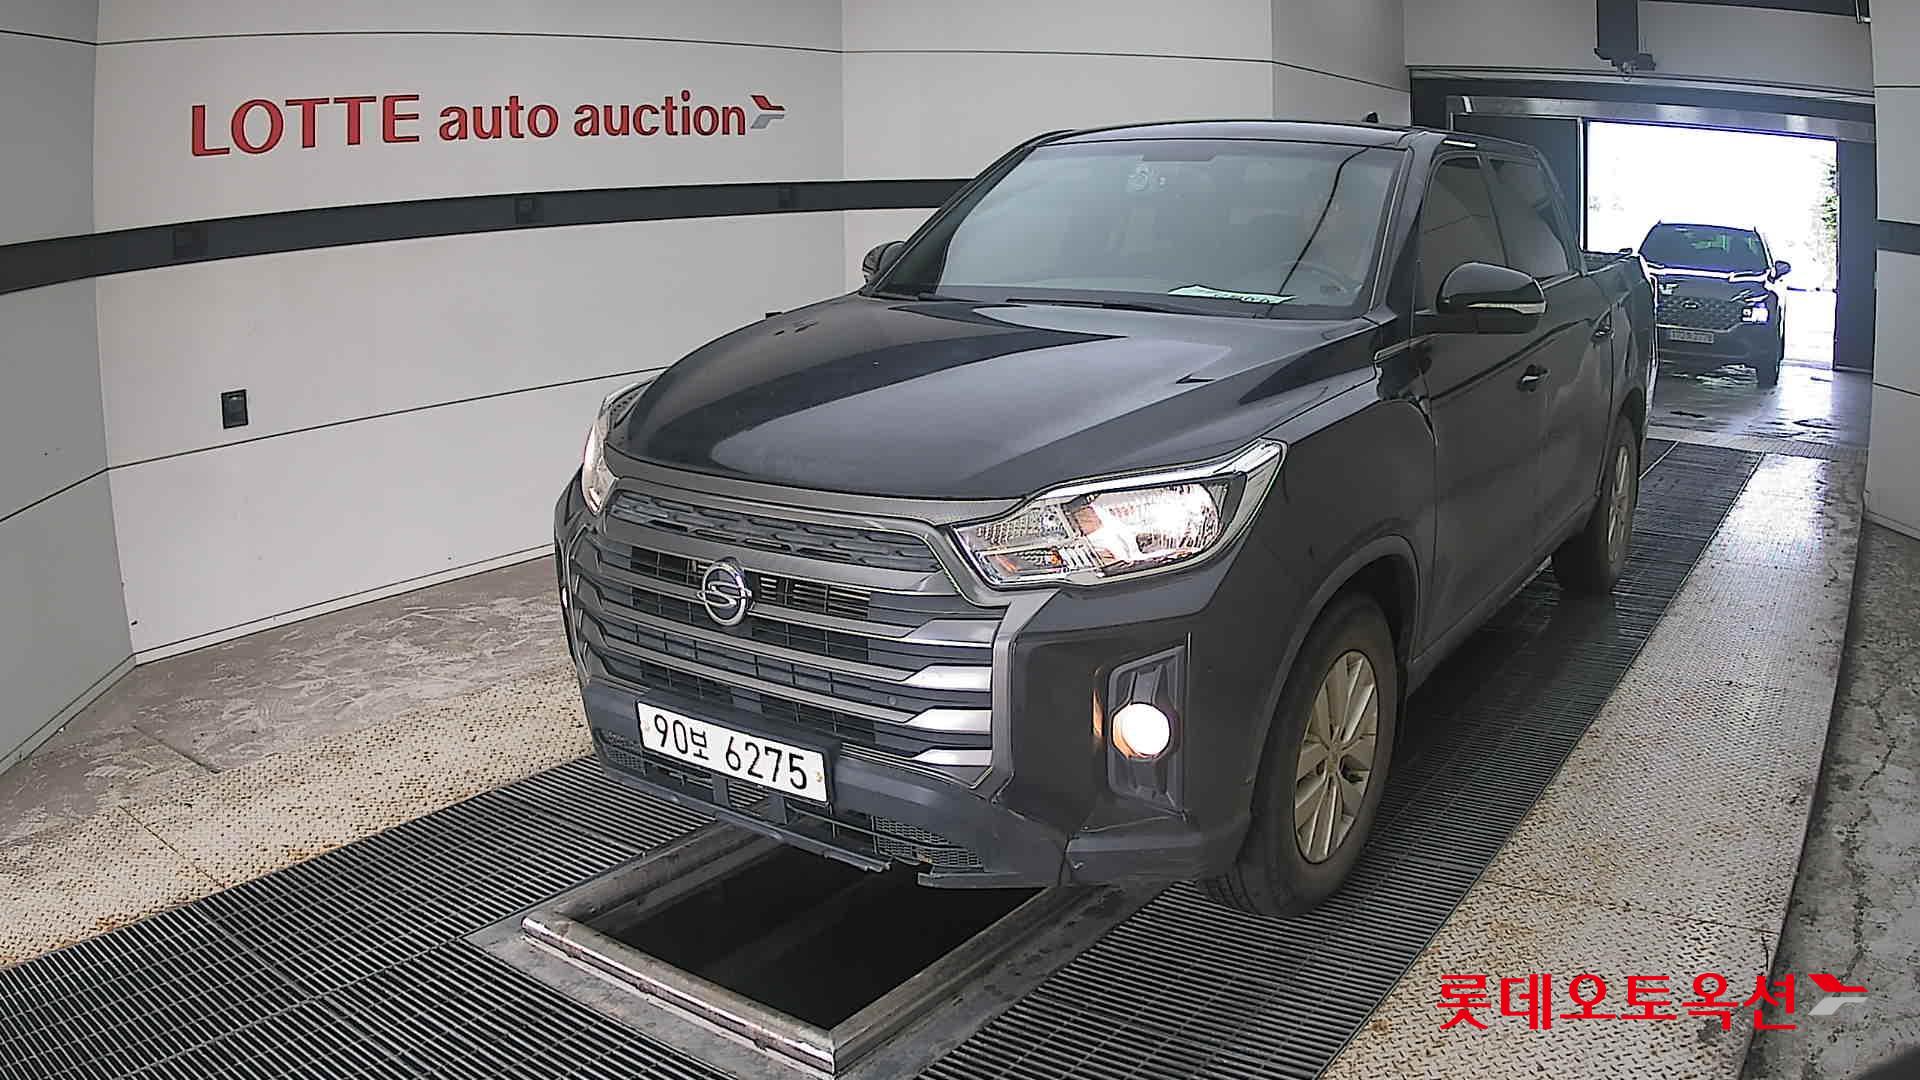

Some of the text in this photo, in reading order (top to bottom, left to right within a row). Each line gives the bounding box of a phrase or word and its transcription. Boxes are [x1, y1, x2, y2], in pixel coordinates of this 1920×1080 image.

[191, 90, 747, 156] LOTTE auto auction
[654, 714, 807, 789] 90보 6275
